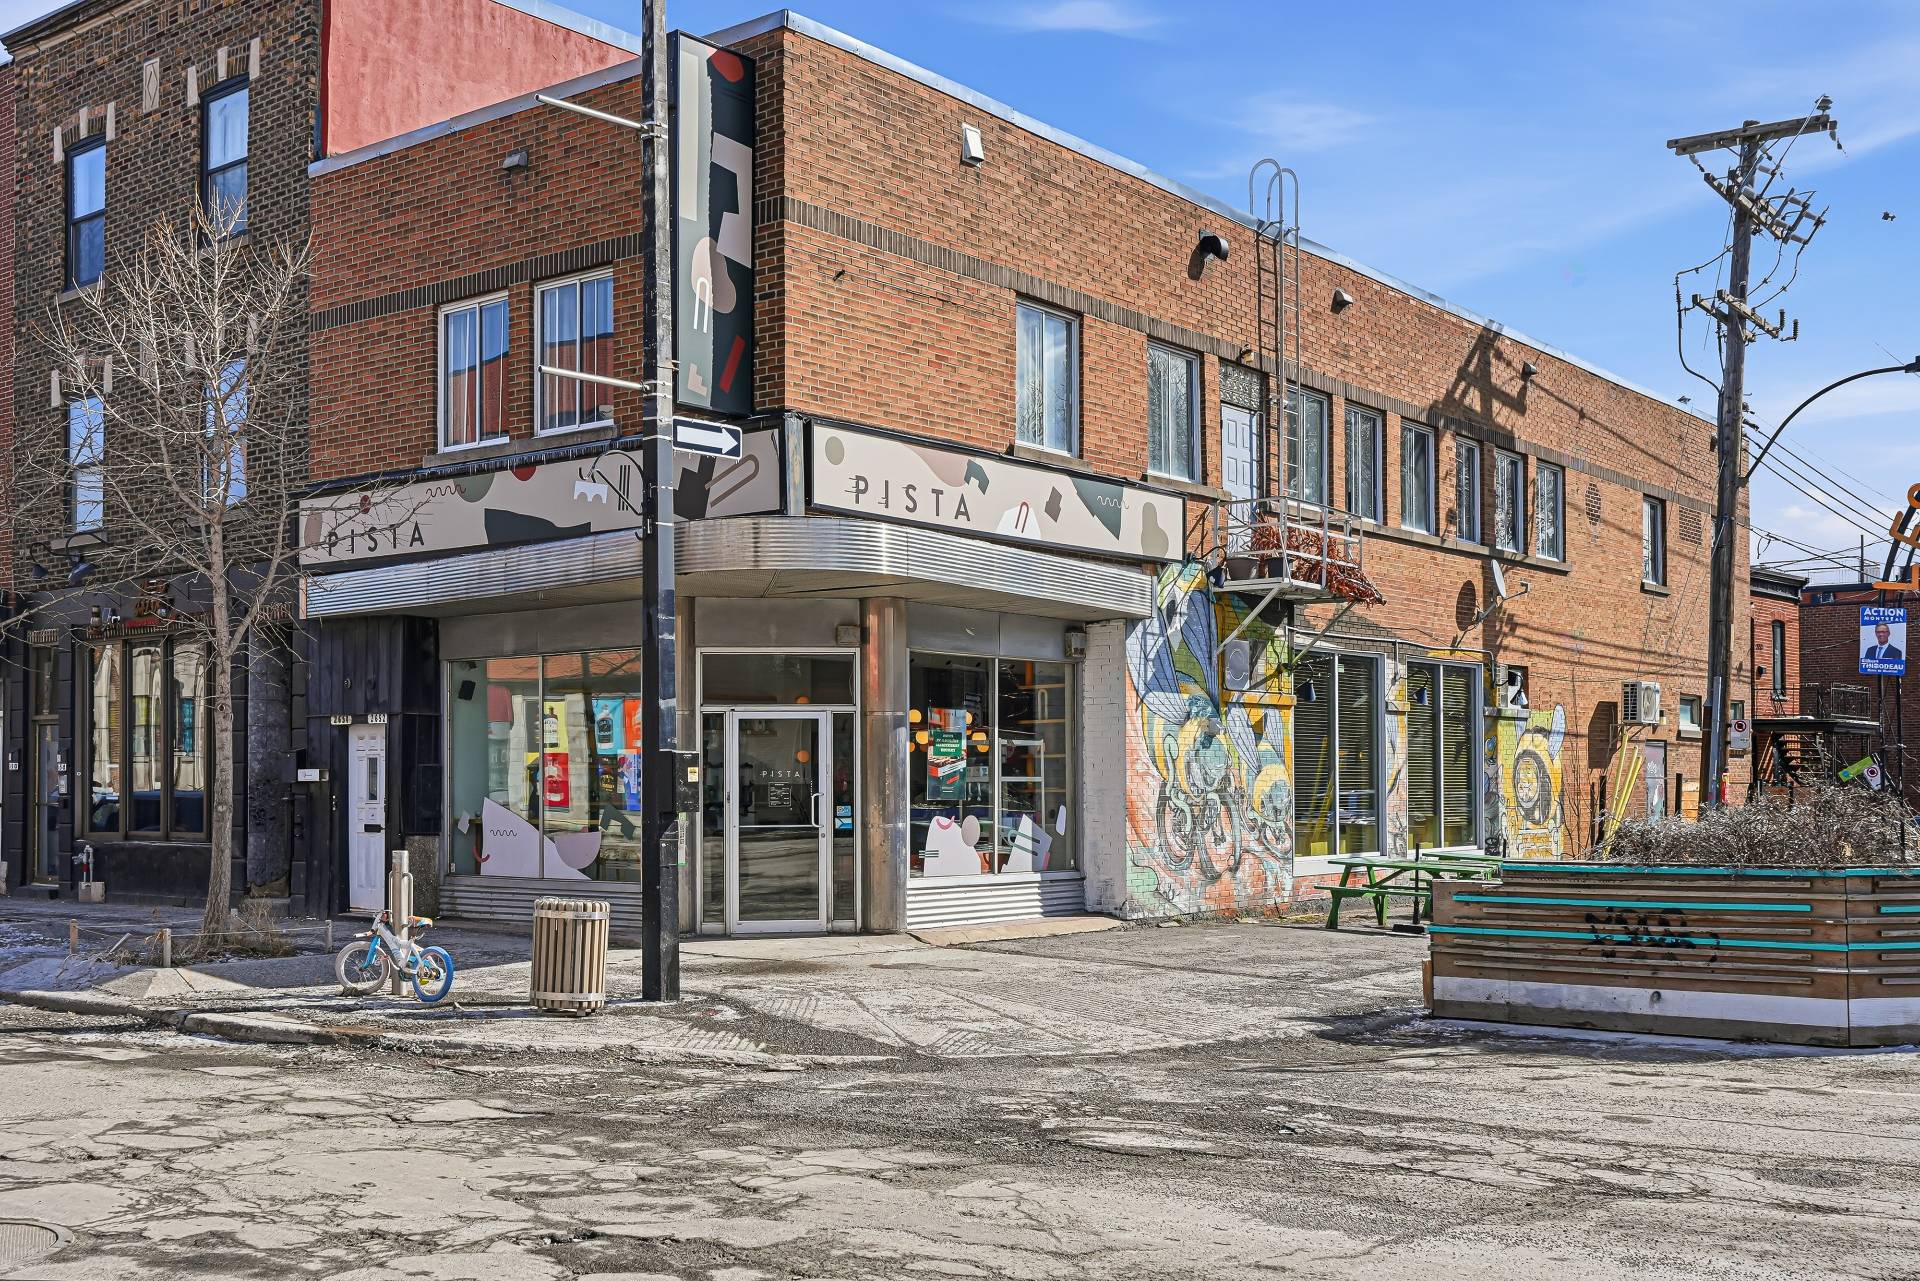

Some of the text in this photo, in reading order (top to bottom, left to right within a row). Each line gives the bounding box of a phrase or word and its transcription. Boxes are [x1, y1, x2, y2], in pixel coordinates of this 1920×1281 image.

[846, 475, 971, 521] PISTA
[326, 520, 425, 556] PISTA
[1863, 607, 1904, 617] ACTION
[761, 770, 800, 778] PISTA
